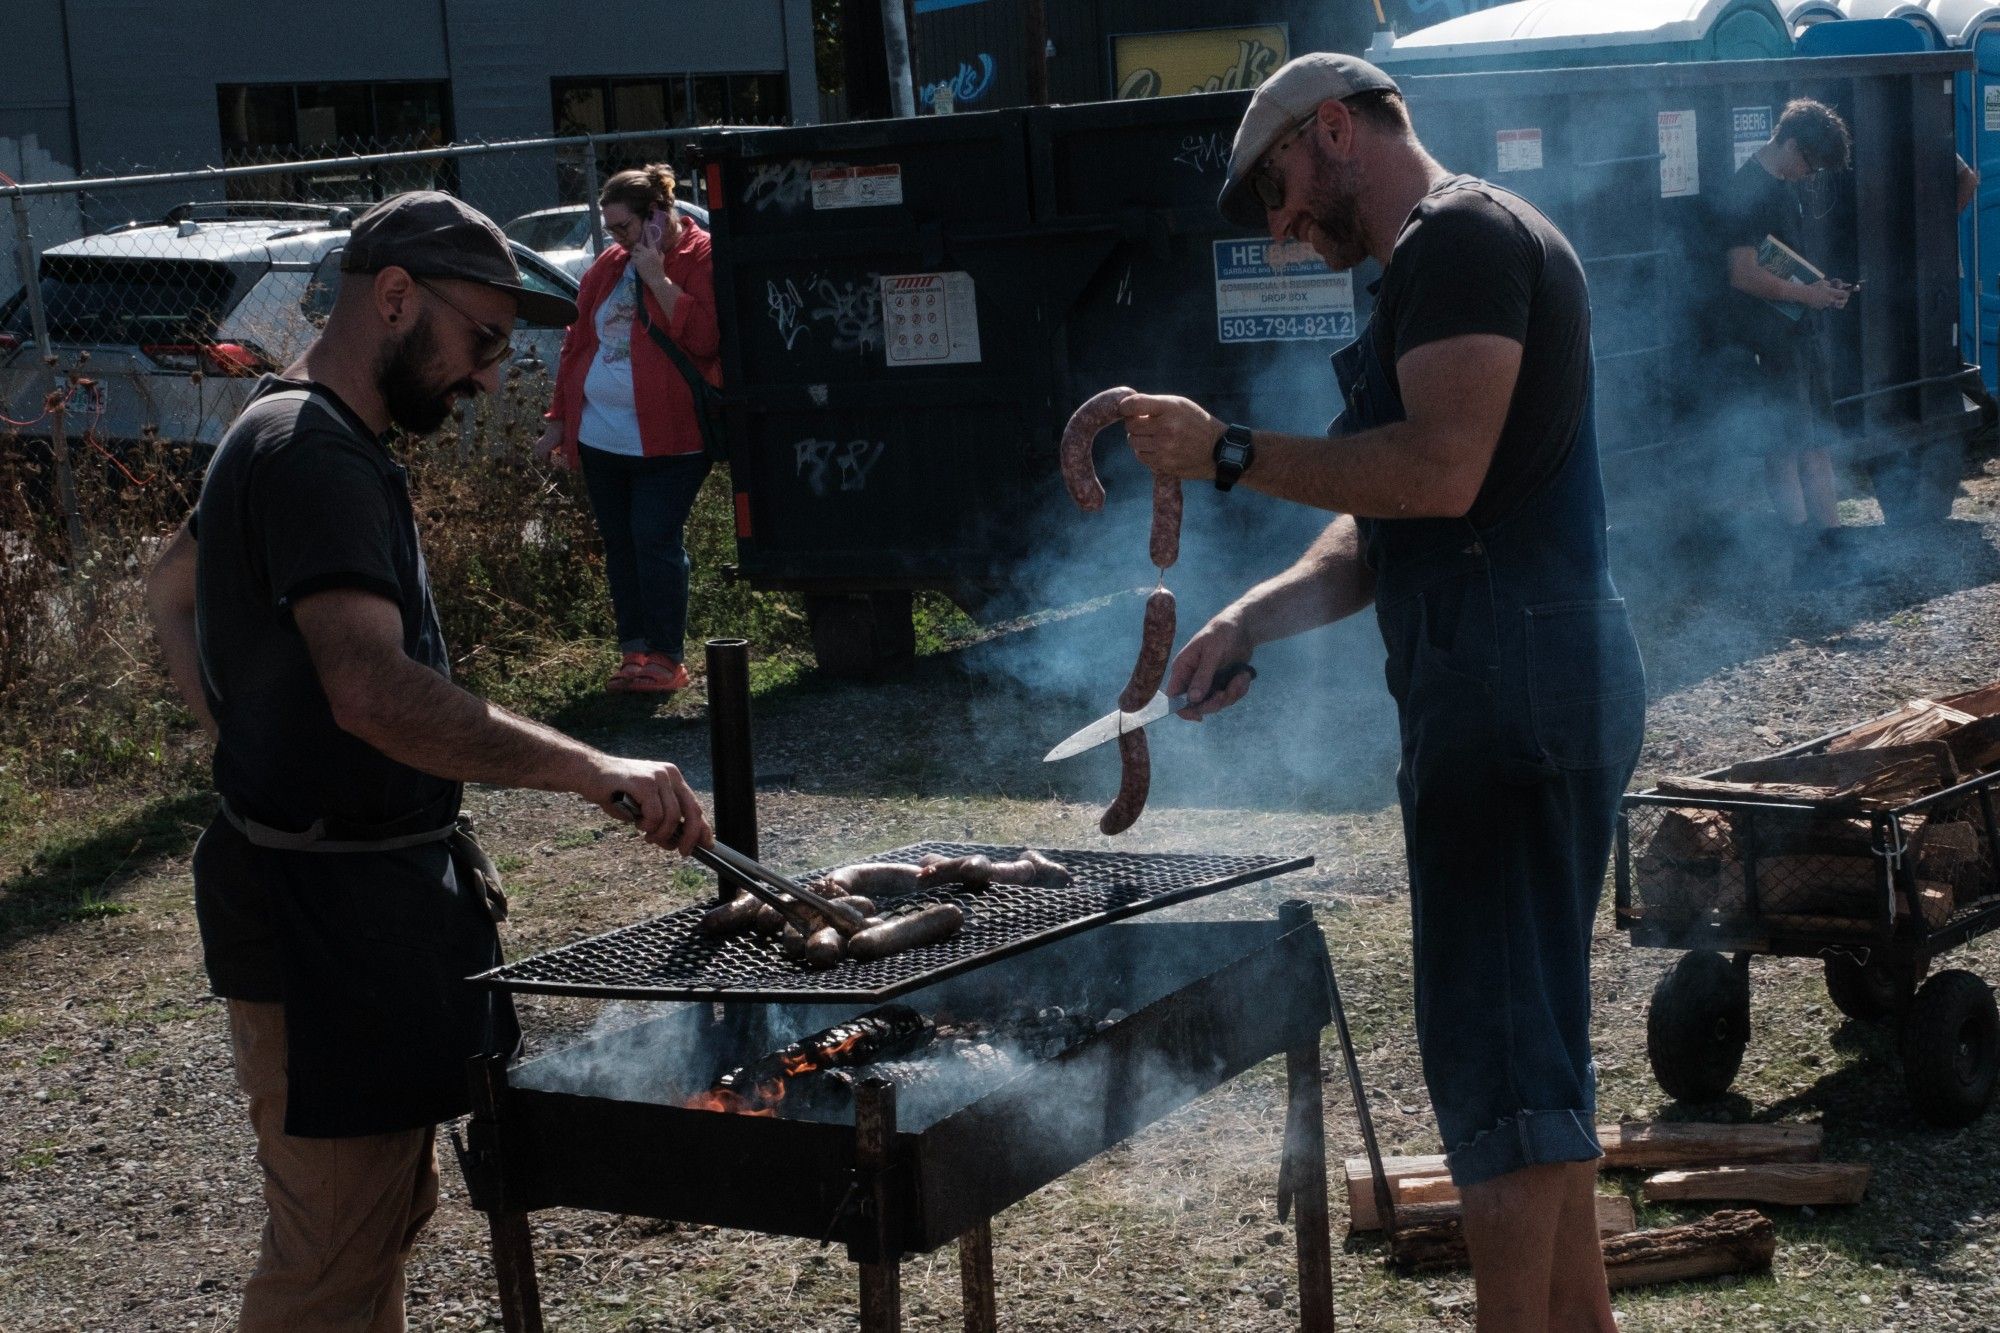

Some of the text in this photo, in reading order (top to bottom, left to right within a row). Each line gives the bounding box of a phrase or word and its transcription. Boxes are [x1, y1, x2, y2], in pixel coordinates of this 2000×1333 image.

[1223, 266, 1257, 276] GARBAGE
[1220, 281, 1278, 292] COMMERCIAL
[1289, 278, 1347, 289] RESIDENTIAL
[1261, 292, 1308, 303] DROP BOX
[1222, 315, 1351, 338] 503-794-8212
